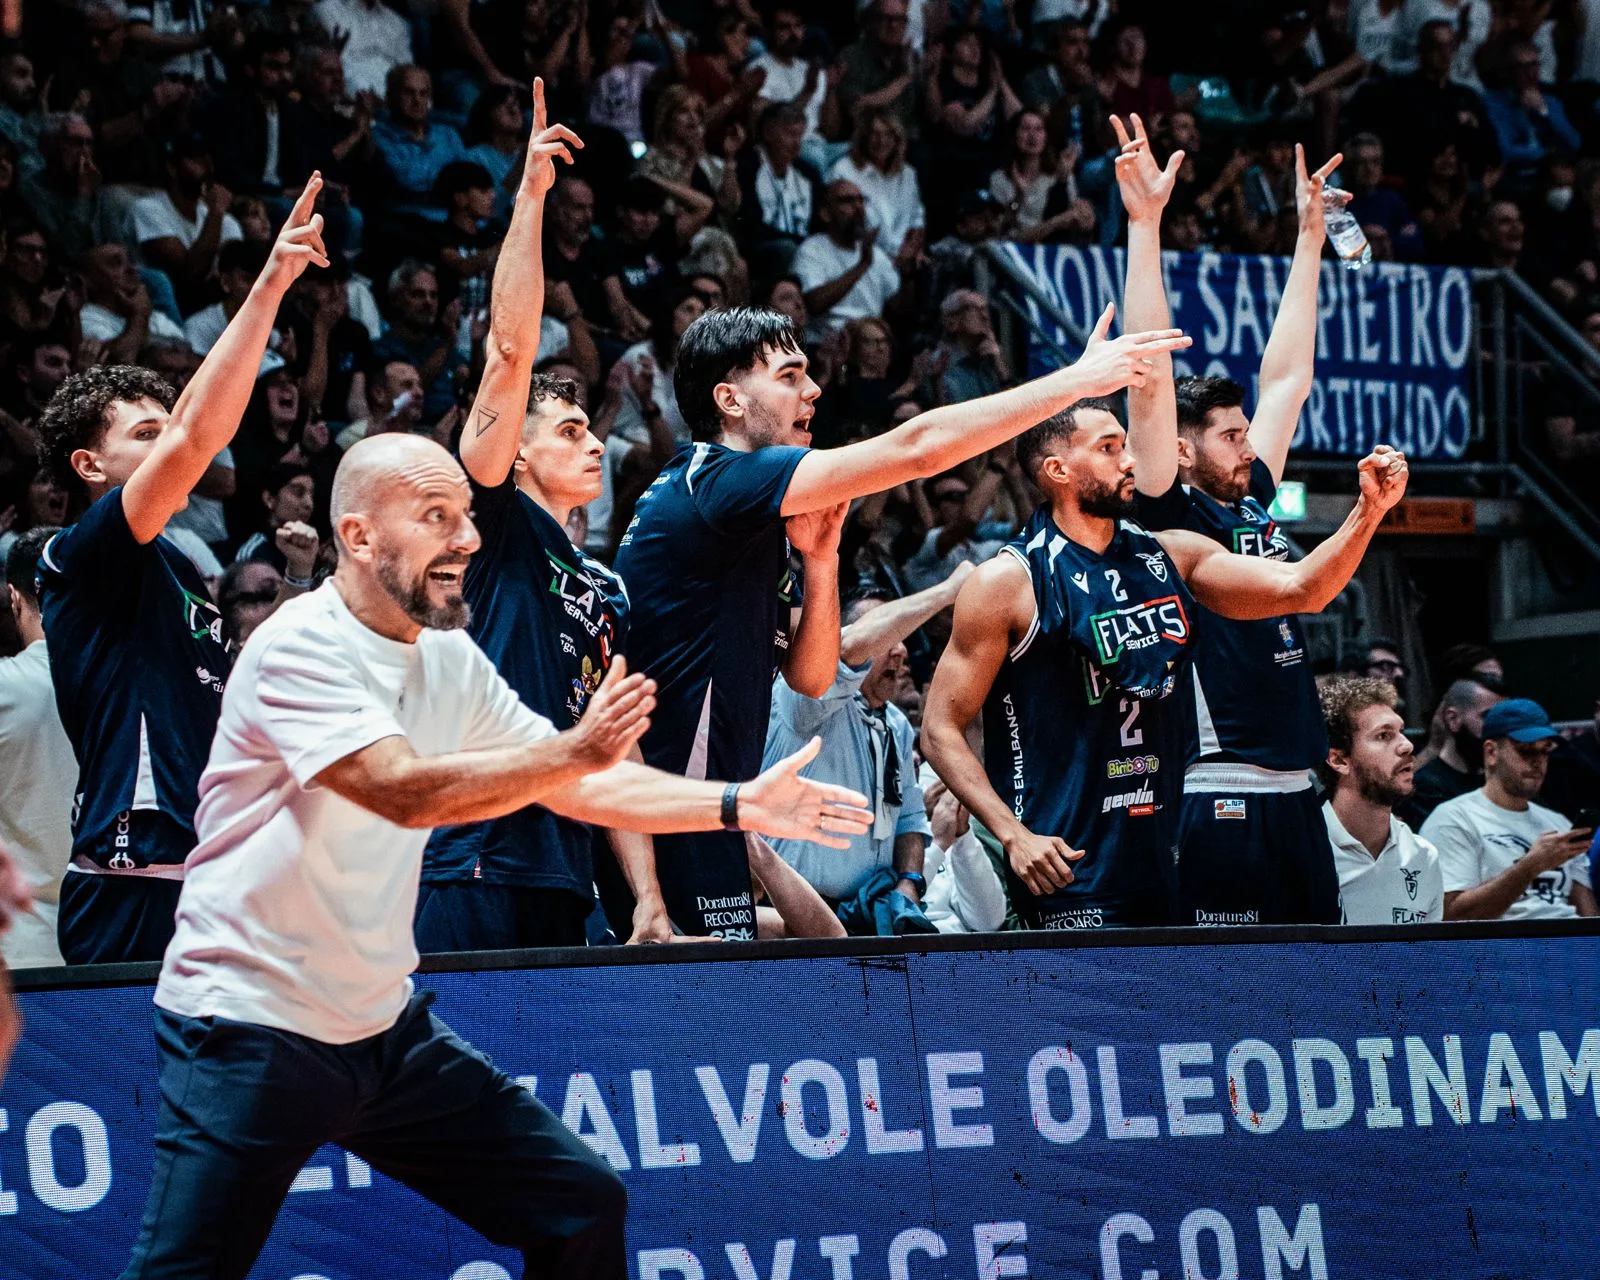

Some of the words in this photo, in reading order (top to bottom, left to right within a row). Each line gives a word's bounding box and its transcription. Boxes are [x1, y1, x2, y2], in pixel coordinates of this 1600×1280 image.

[1003, 242, 1188, 352] MONE
[1315, 262, 1472, 370] PIETRO
[1252, 373, 1471, 458] RTITUDO
[1104, 569, 1128, 602] 2
[1097, 602, 1186, 658] FLATS
[1003, 693, 1025, 789] EMILBANCA
[1119, 697, 1143, 747] 2
[115, 811, 130, 847] BCC
[703, 909, 753, 928] RECOARO
[1195, 909, 1259, 923] Doratura84
[514, 1051, 995, 1170] ALVOLE
[1027, 1028, 1600, 1144] OLEODINAM
